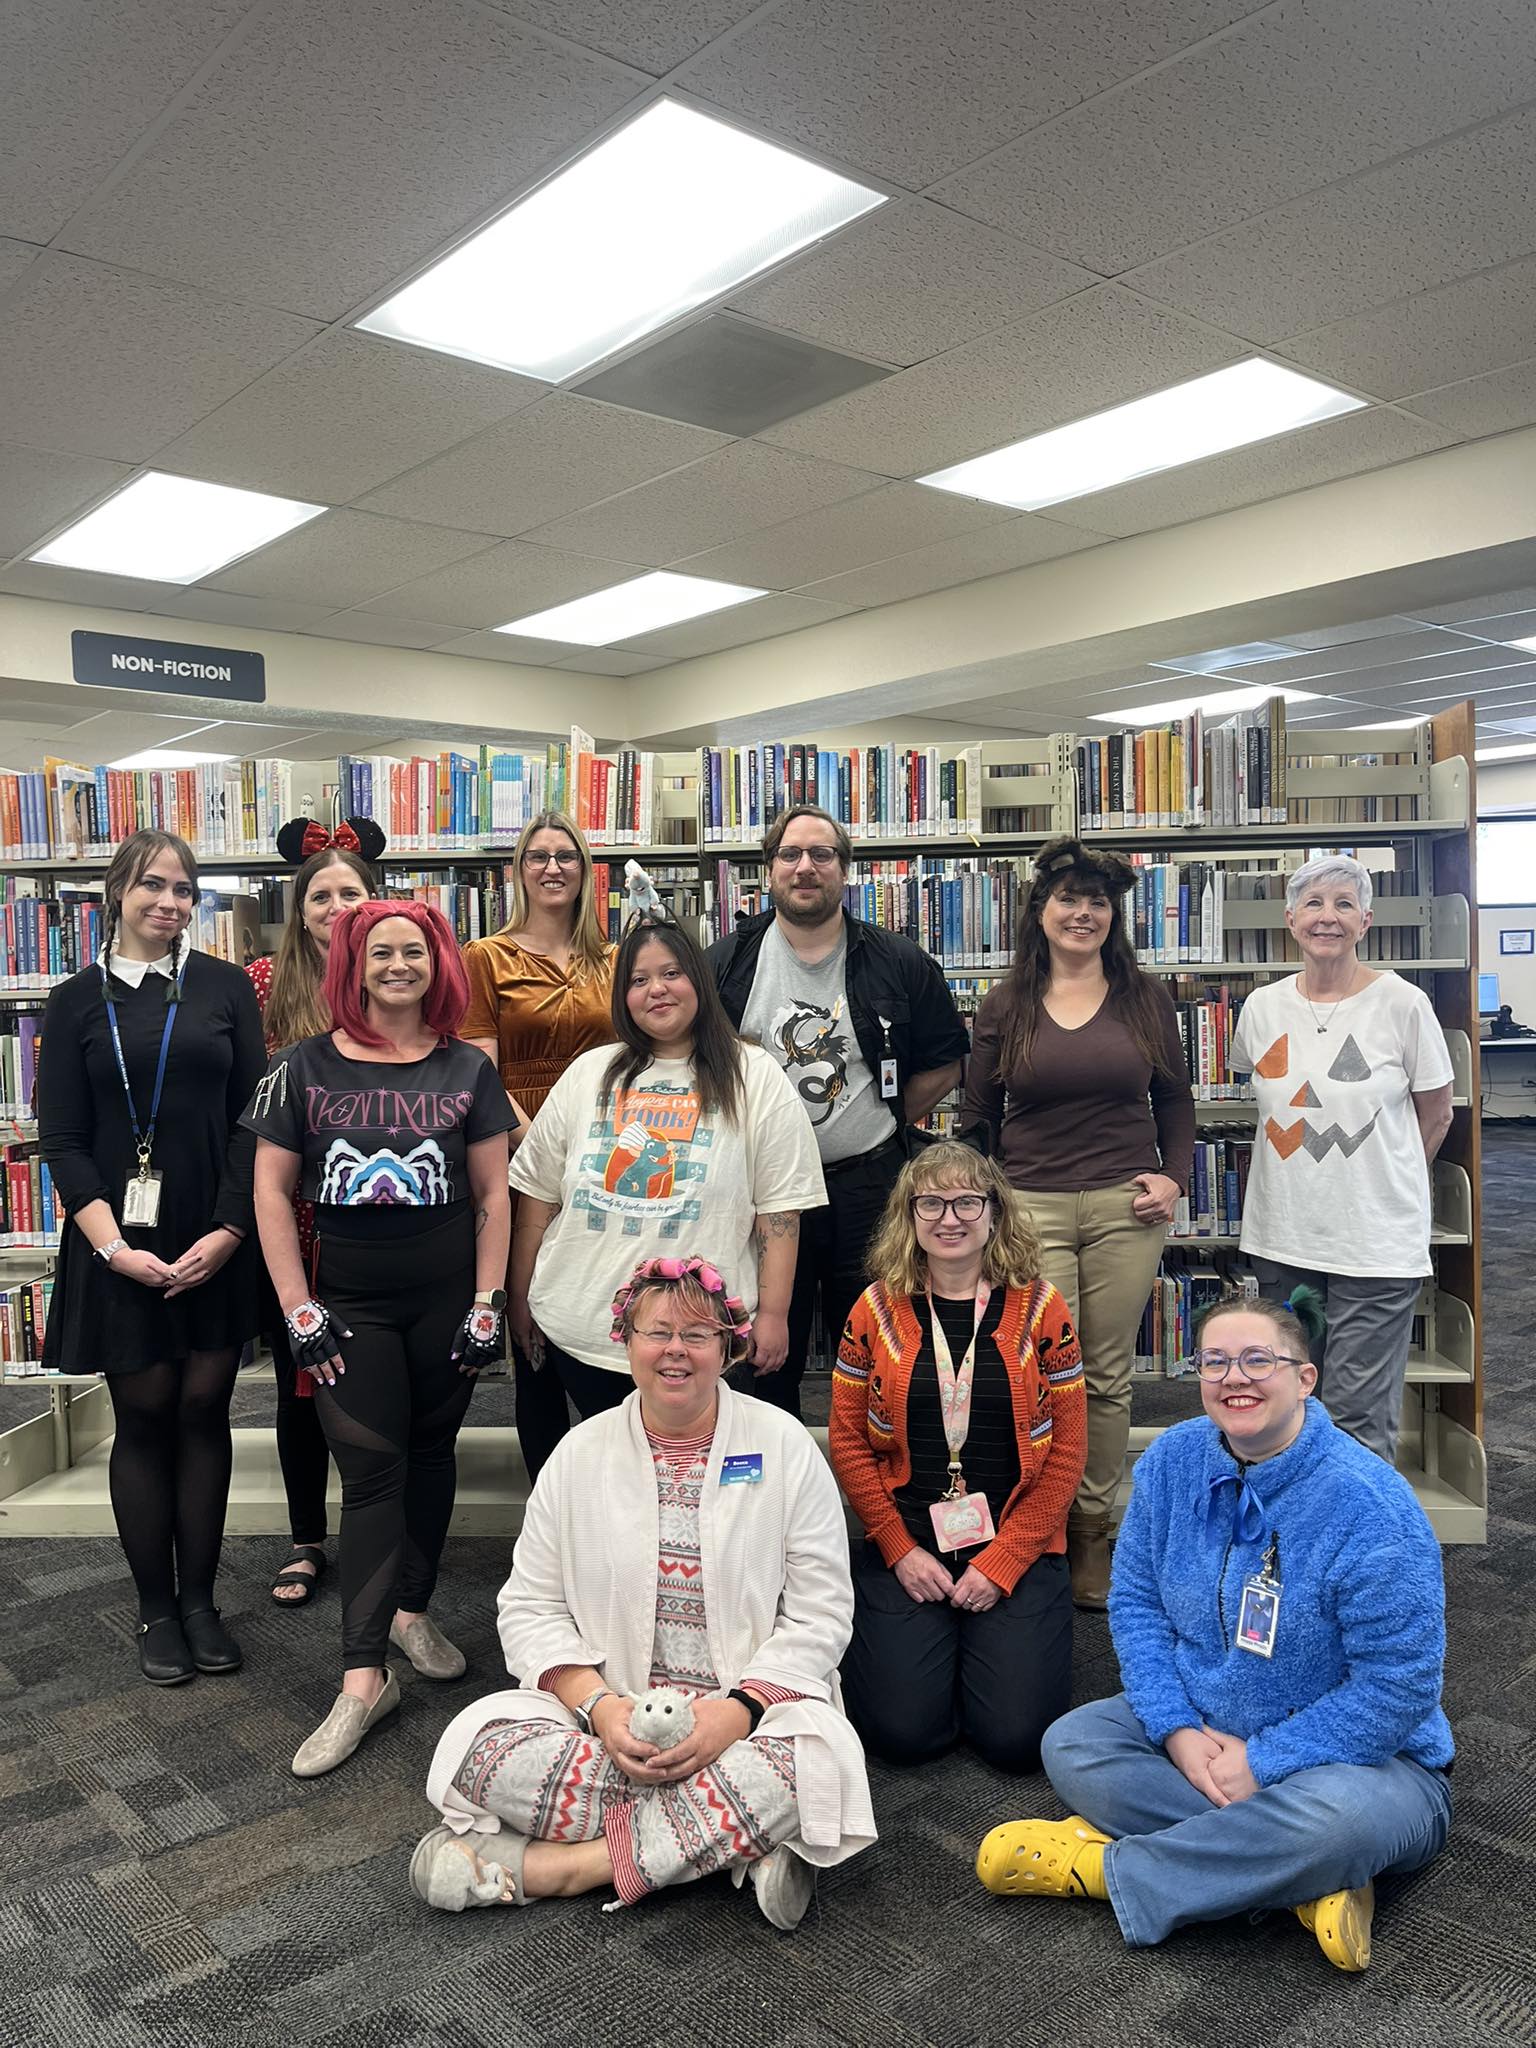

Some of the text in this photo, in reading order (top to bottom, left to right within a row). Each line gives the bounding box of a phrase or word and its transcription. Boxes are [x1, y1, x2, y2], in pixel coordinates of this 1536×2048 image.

[111, 653, 231, 682] NON-FICTION
[765, 748, 774, 807] ARMAGEDDON
[40, 936, 46, 947] TO
[621, 1109, 693, 1128] COOK!
